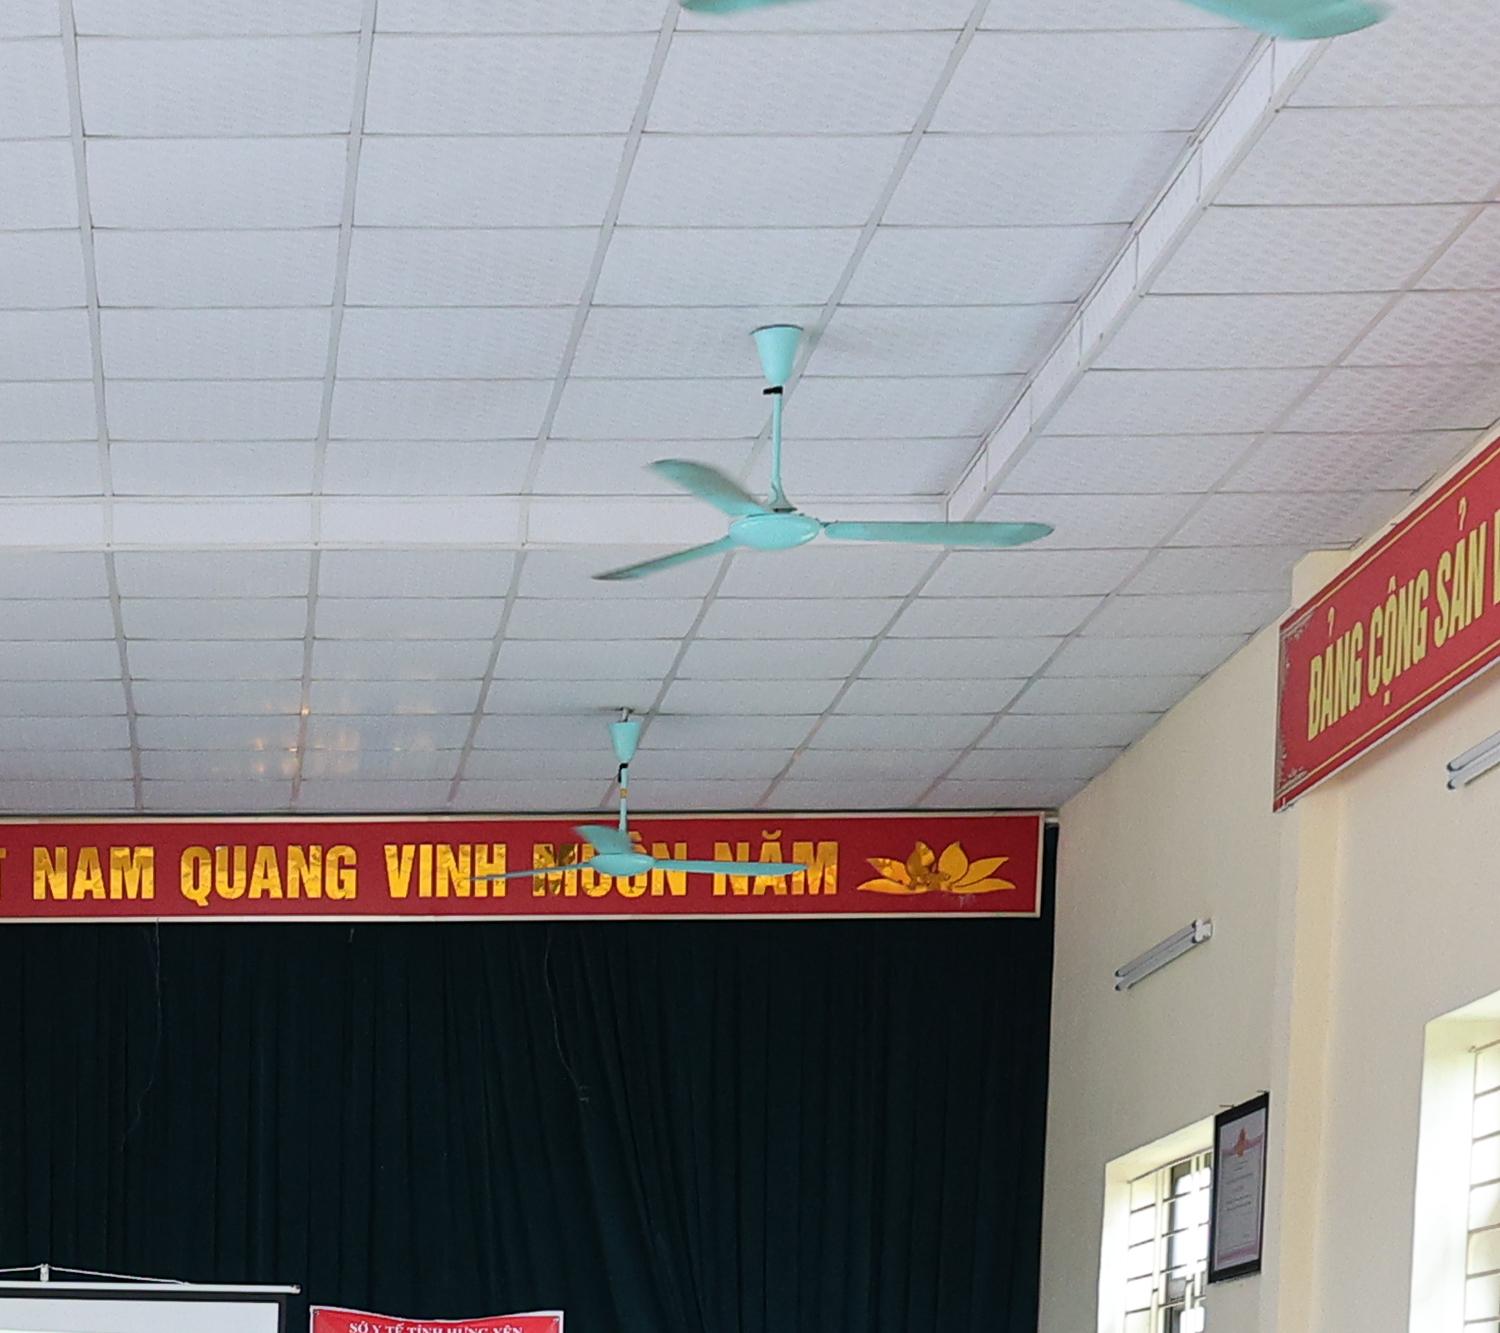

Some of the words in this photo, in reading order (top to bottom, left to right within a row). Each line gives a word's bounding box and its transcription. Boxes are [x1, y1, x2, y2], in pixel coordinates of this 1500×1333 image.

[1306, 607, 1364, 740] ĐẢNG
[1366, 568, 1429, 705] CỘNG
[1433, 497, 1487, 648] SẢN
[33, 847, 155, 901] NAM
[180, 845, 356, 905] QUANG
[384, 842, 507, 898] VINH
[713, 830, 838, 896] NĂM
